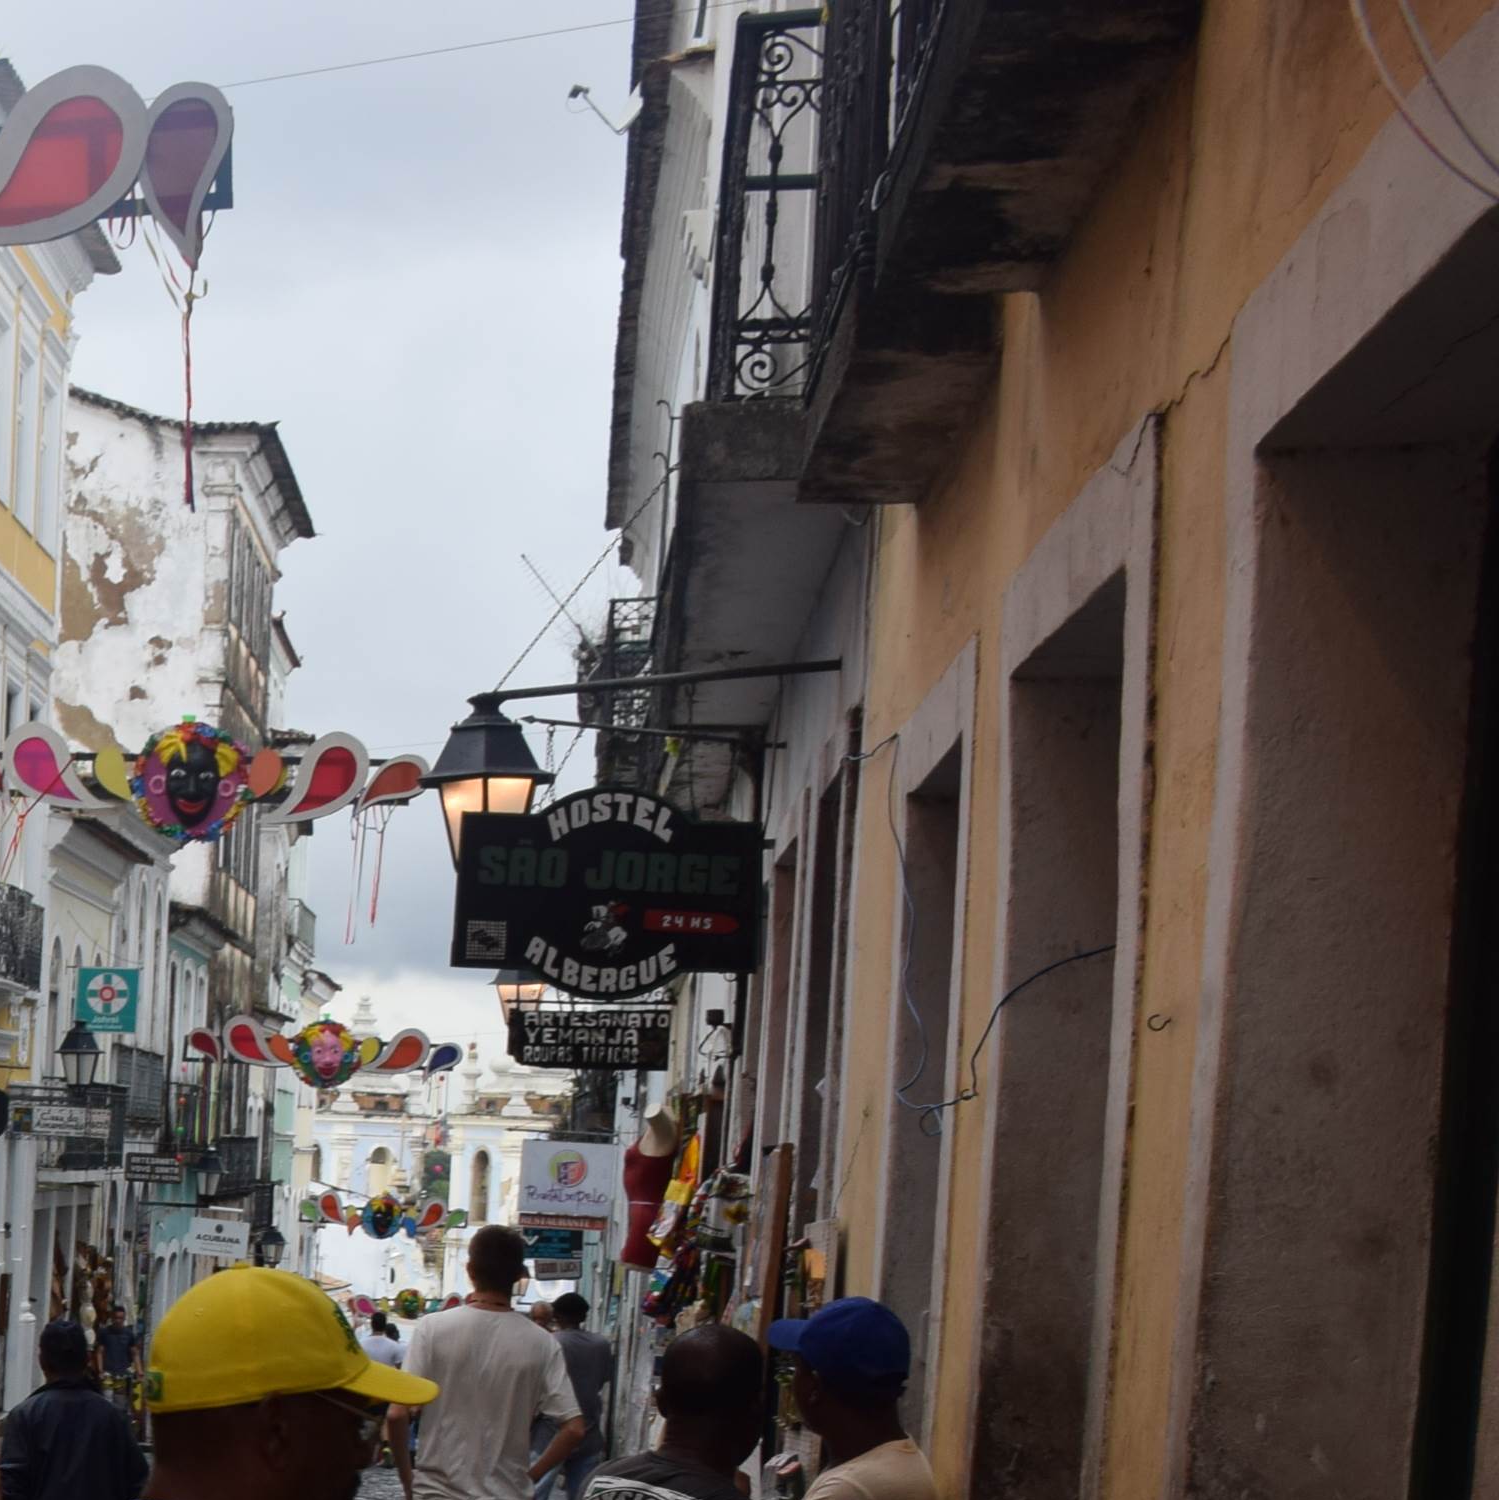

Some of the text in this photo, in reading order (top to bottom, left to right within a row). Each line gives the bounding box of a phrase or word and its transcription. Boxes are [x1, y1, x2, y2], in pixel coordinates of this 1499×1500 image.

[547, 793, 674, 843] HOSTEL
[477, 839, 742, 896] SÃO JORGE
[661, 914, 713, 931] 24 HS
[524, 935, 678, 993] ALBERGUE
[524, 1011, 670, 1029] ARTESANATO
[523, 1045, 574, 1063] ROUPAS
